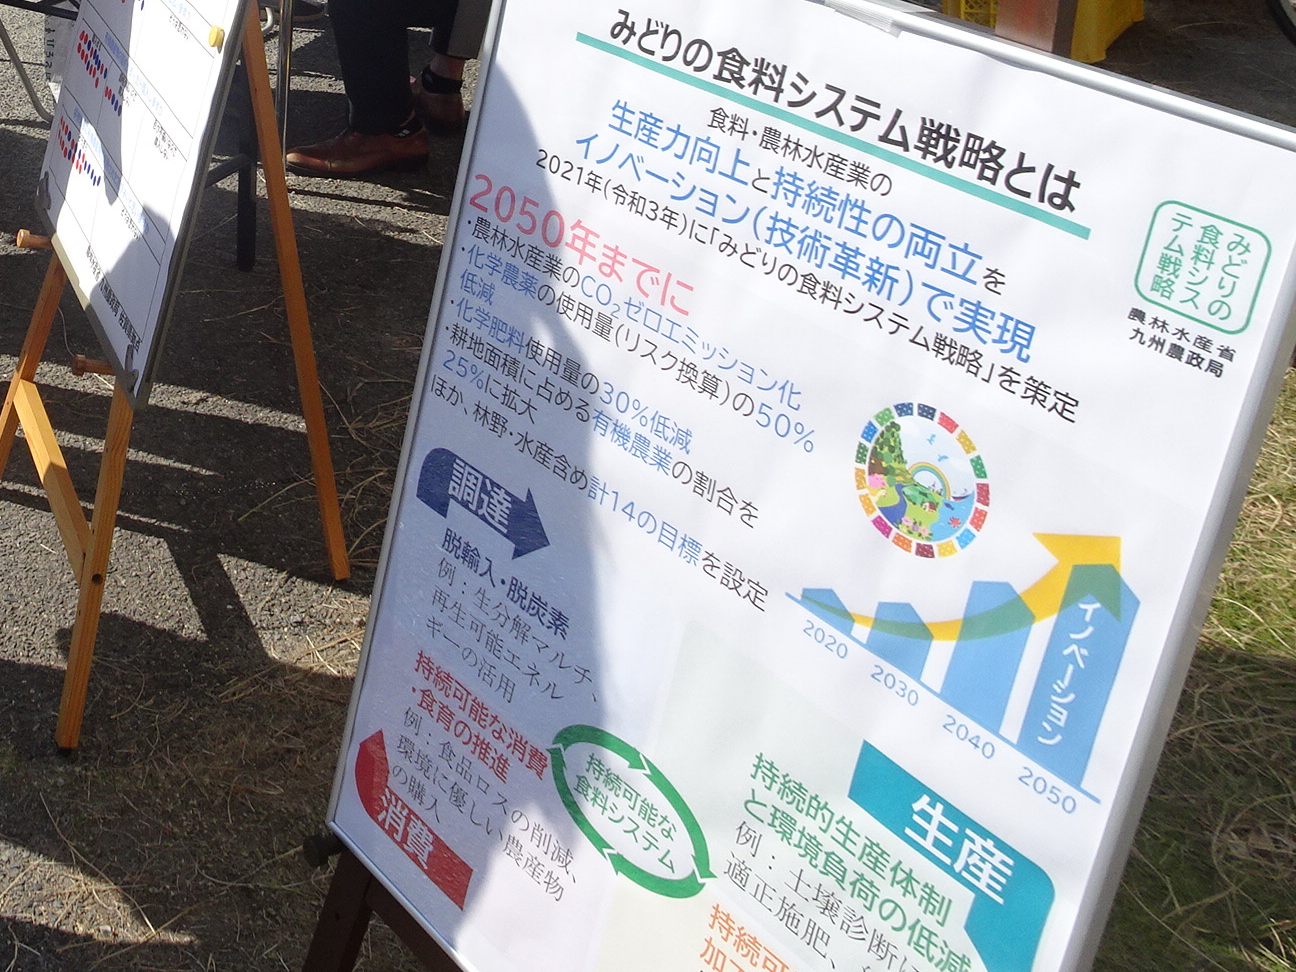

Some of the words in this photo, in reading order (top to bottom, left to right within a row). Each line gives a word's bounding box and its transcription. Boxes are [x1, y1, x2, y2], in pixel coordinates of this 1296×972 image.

[609, 8, 1082, 214] みどりの食料システム戦略とは
[707, 106, 894, 197] 食料・農林水産業の
[469, 174, 694, 317] 2050年までに
[576, 132, 1037, 364] イノベーション(技術革新)で実現
[608, 99, 1007, 296] 生産力向上と持続性の両立を
[459, 269, 496, 306] 低減
[535, 149, 1080, 423] 2021年(令和3年)に「みどりの食料システム戦略」を策定
[1150, 212, 1193, 300] テム戦略
[1179, 224, 1223, 310] 食料シス
[1207, 232, 1251, 321] みどりの
[443, 349, 537, 424] 25%に拡大
[1127, 307, 1237, 362] 農林水産省
[1129, 327, 1224, 378] 九州農政局
[429, 373, 769, 612] ほか、林野・水産含め計14の目標を設定
[448, 457, 512, 534] 調達
[437, 558, 597, 702] 例：生分解マルチ、
[441, 528, 570, 641] 脱輸入・脱炭素
[426, 616, 516, 704] ギーの活用
[431, 585, 564, 702] 再生可能エネル
[1037, 600, 1102, 747] イノベーション
[413, 650, 550, 781] 持続可能な消費
[803, 620, 849, 660] 2020
[871, 665, 919, 707] 2030
[942, 715, 996, 761] 2040
[1018, 766, 1078, 816] 2050
[377, 787, 434, 870] 消費
[392, 765, 441, 823] の購入
[396, 734, 564, 902] 環境に優しい農産物
[403, 707, 577, 883] 例：食品ロスの削減、
[574, 774, 675, 874] 食料システム
[586, 753, 677, 842] 持続可能な
[750, 752, 952, 927] 持続的生産体制
[904, 793, 1014, 905] 生産
[744, 788, 972, 972] と環境負荷の低減
